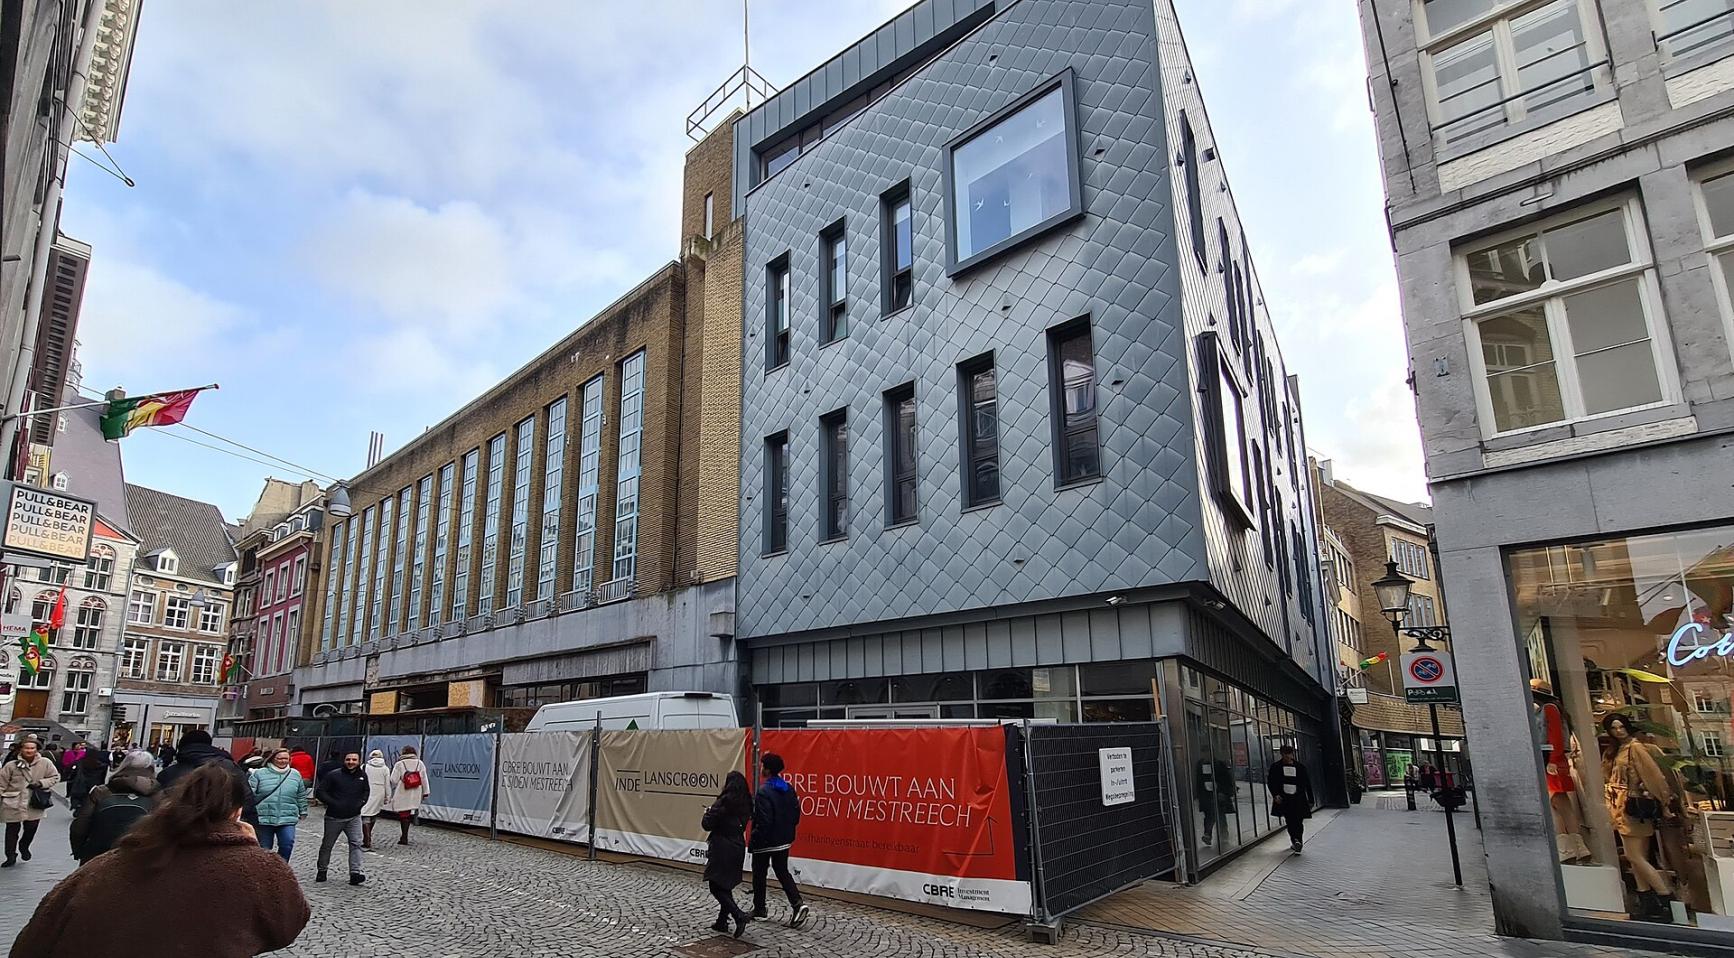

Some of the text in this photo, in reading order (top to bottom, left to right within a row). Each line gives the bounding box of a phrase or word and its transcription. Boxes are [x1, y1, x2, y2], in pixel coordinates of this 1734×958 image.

[17, 490, 89, 514] PULL&BEAR
[13, 512, 85, 535] PULL&BEAR
[15, 501, 87, 525] PULL&BEAR
[9, 534, 81, 555] PULL&BEAR
[11, 523, 83, 545] PULL&BEAR
[444, 762, 481, 775] LANSCROON
[522, 761, 551, 775] BOUWT
[552, 762, 569, 776] AAN
[644, 770, 719, 788] LANSCROON
[615, 777, 641, 792] INDE
[783, 772, 955, 800] BRE BOUWT AAN
[846, 798, 972, 828] MESTREECH
[922, 883, 955, 899] CBRE
